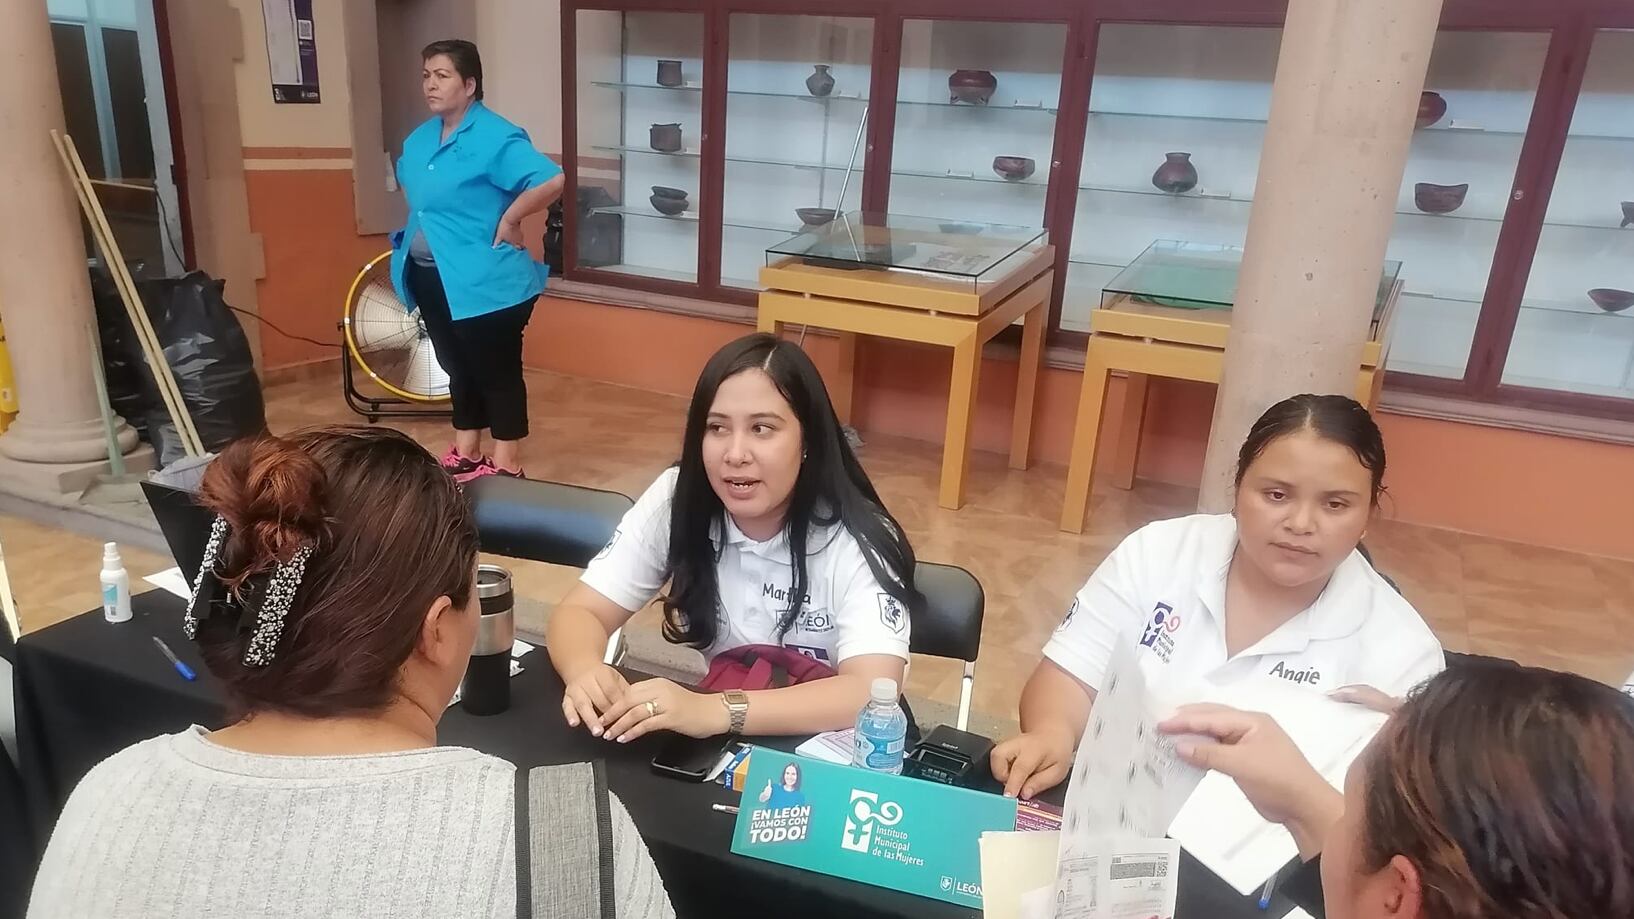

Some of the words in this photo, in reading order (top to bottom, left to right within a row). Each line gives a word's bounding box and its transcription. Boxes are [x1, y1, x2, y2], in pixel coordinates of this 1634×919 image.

[762, 583, 811, 604] Mara
[752, 809, 772, 821] EN
[773, 804, 811, 819] LEÓN
[750, 819, 787, 830] ¡VAMOS
[788, 816, 809, 826] CON
[749, 825, 808, 844] TODO!
[876, 825, 909, 840] Instituto
[874, 835, 911, 852] Municipal
[872, 847, 882, 857] de
[883, 849, 895, 860] las
[895, 850, 925, 866] Mujeres
